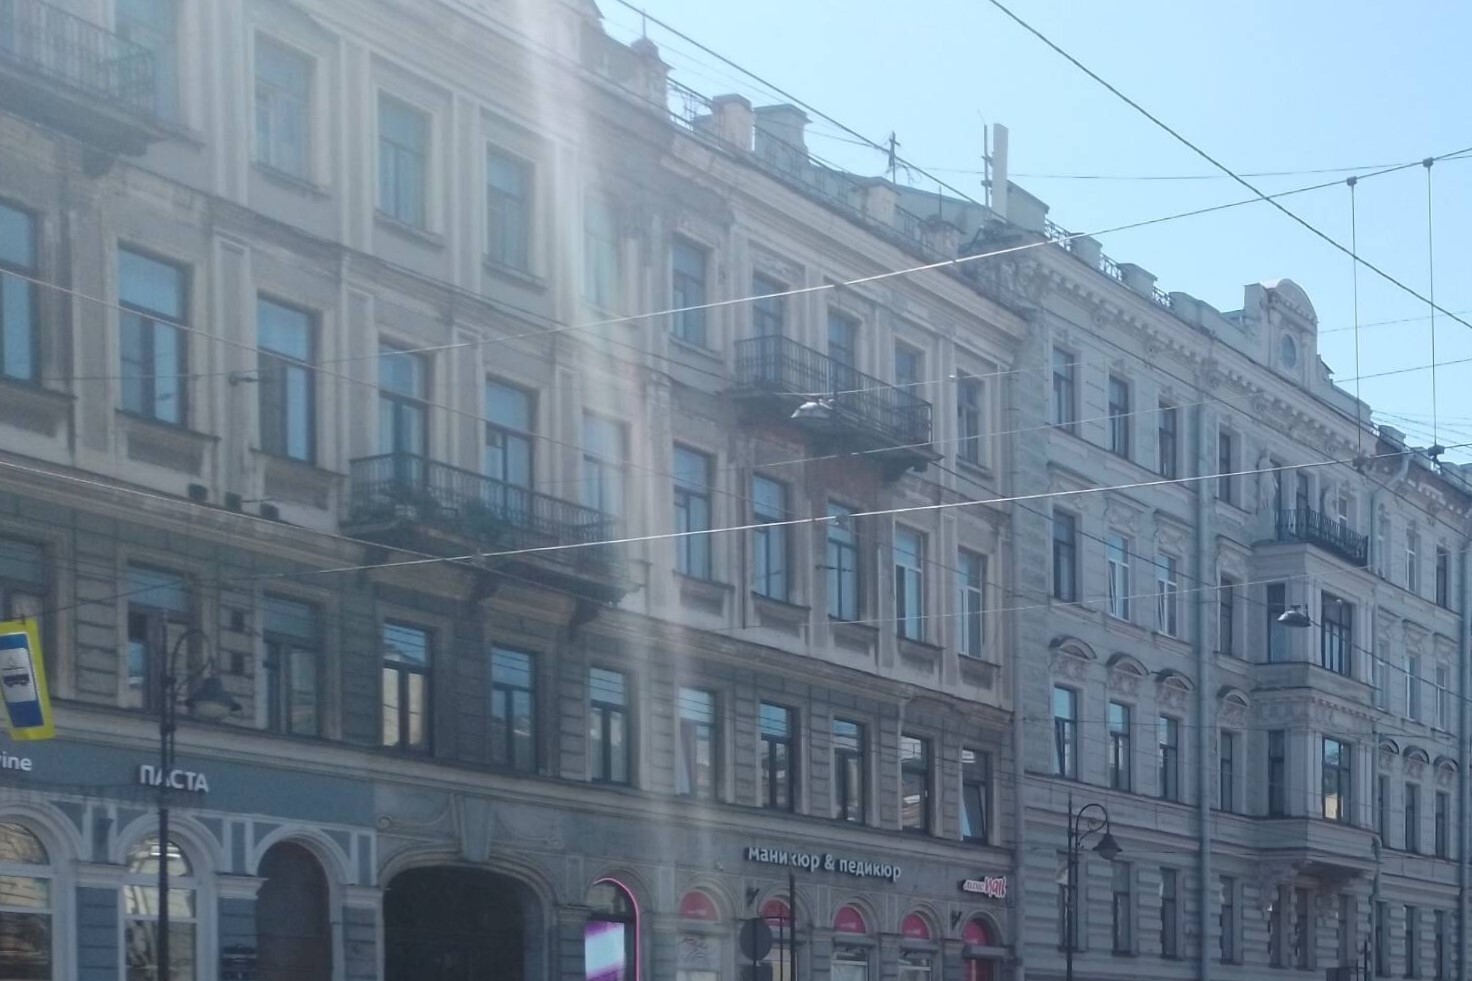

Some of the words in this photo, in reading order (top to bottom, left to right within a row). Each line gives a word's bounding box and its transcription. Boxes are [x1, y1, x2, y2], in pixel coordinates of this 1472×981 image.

[0, 751, 33, 772] ine
[140, 764, 210, 793] ПАСТА
[824, 854, 835, 871] &
[839, 860, 901, 882] педикюр
